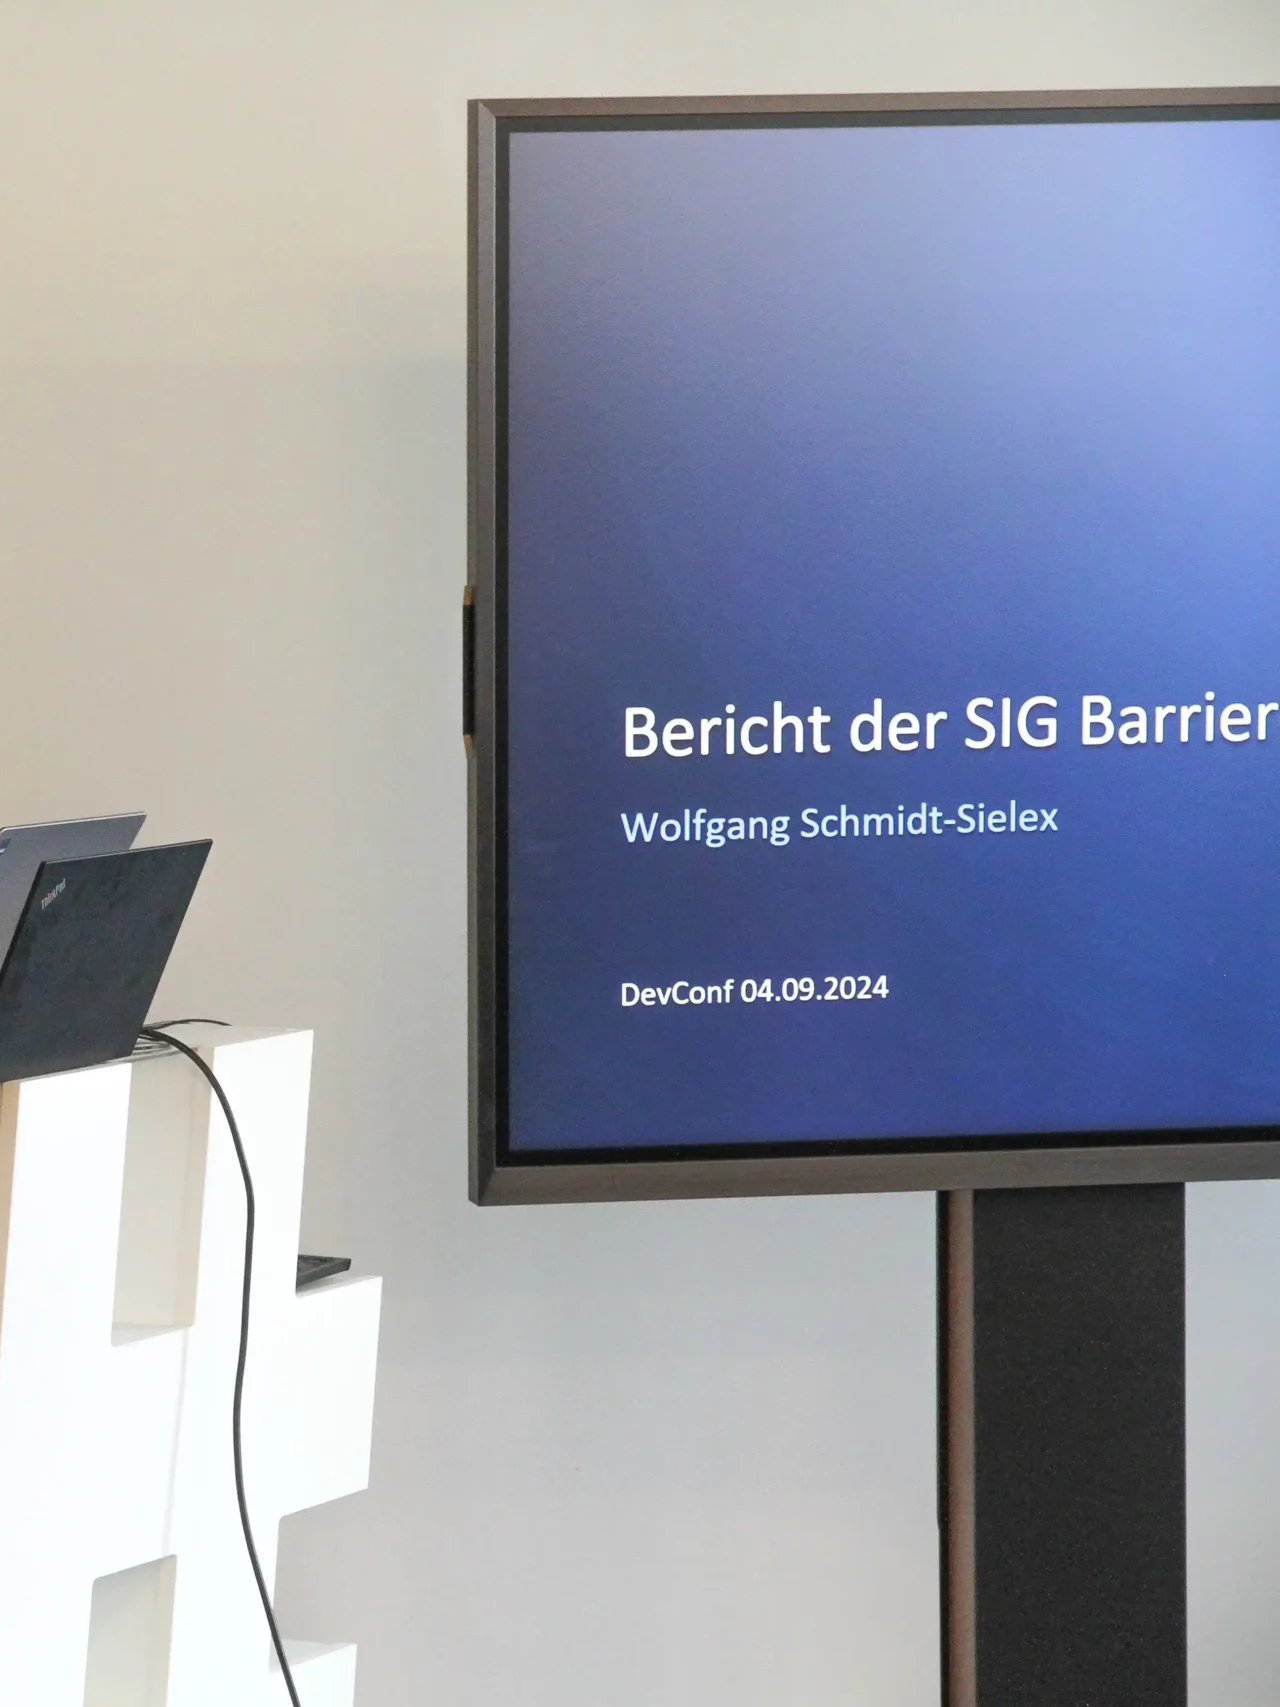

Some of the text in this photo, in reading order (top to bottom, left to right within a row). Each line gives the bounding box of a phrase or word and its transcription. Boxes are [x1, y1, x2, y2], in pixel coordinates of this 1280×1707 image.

[626, 691, 1279, 757] Bericht der SIG Barrier
[621, 800, 1057, 847] Wolfgang Schmidt-Sielex
[622, 975, 889, 1006] DevConf 04.09.2024
